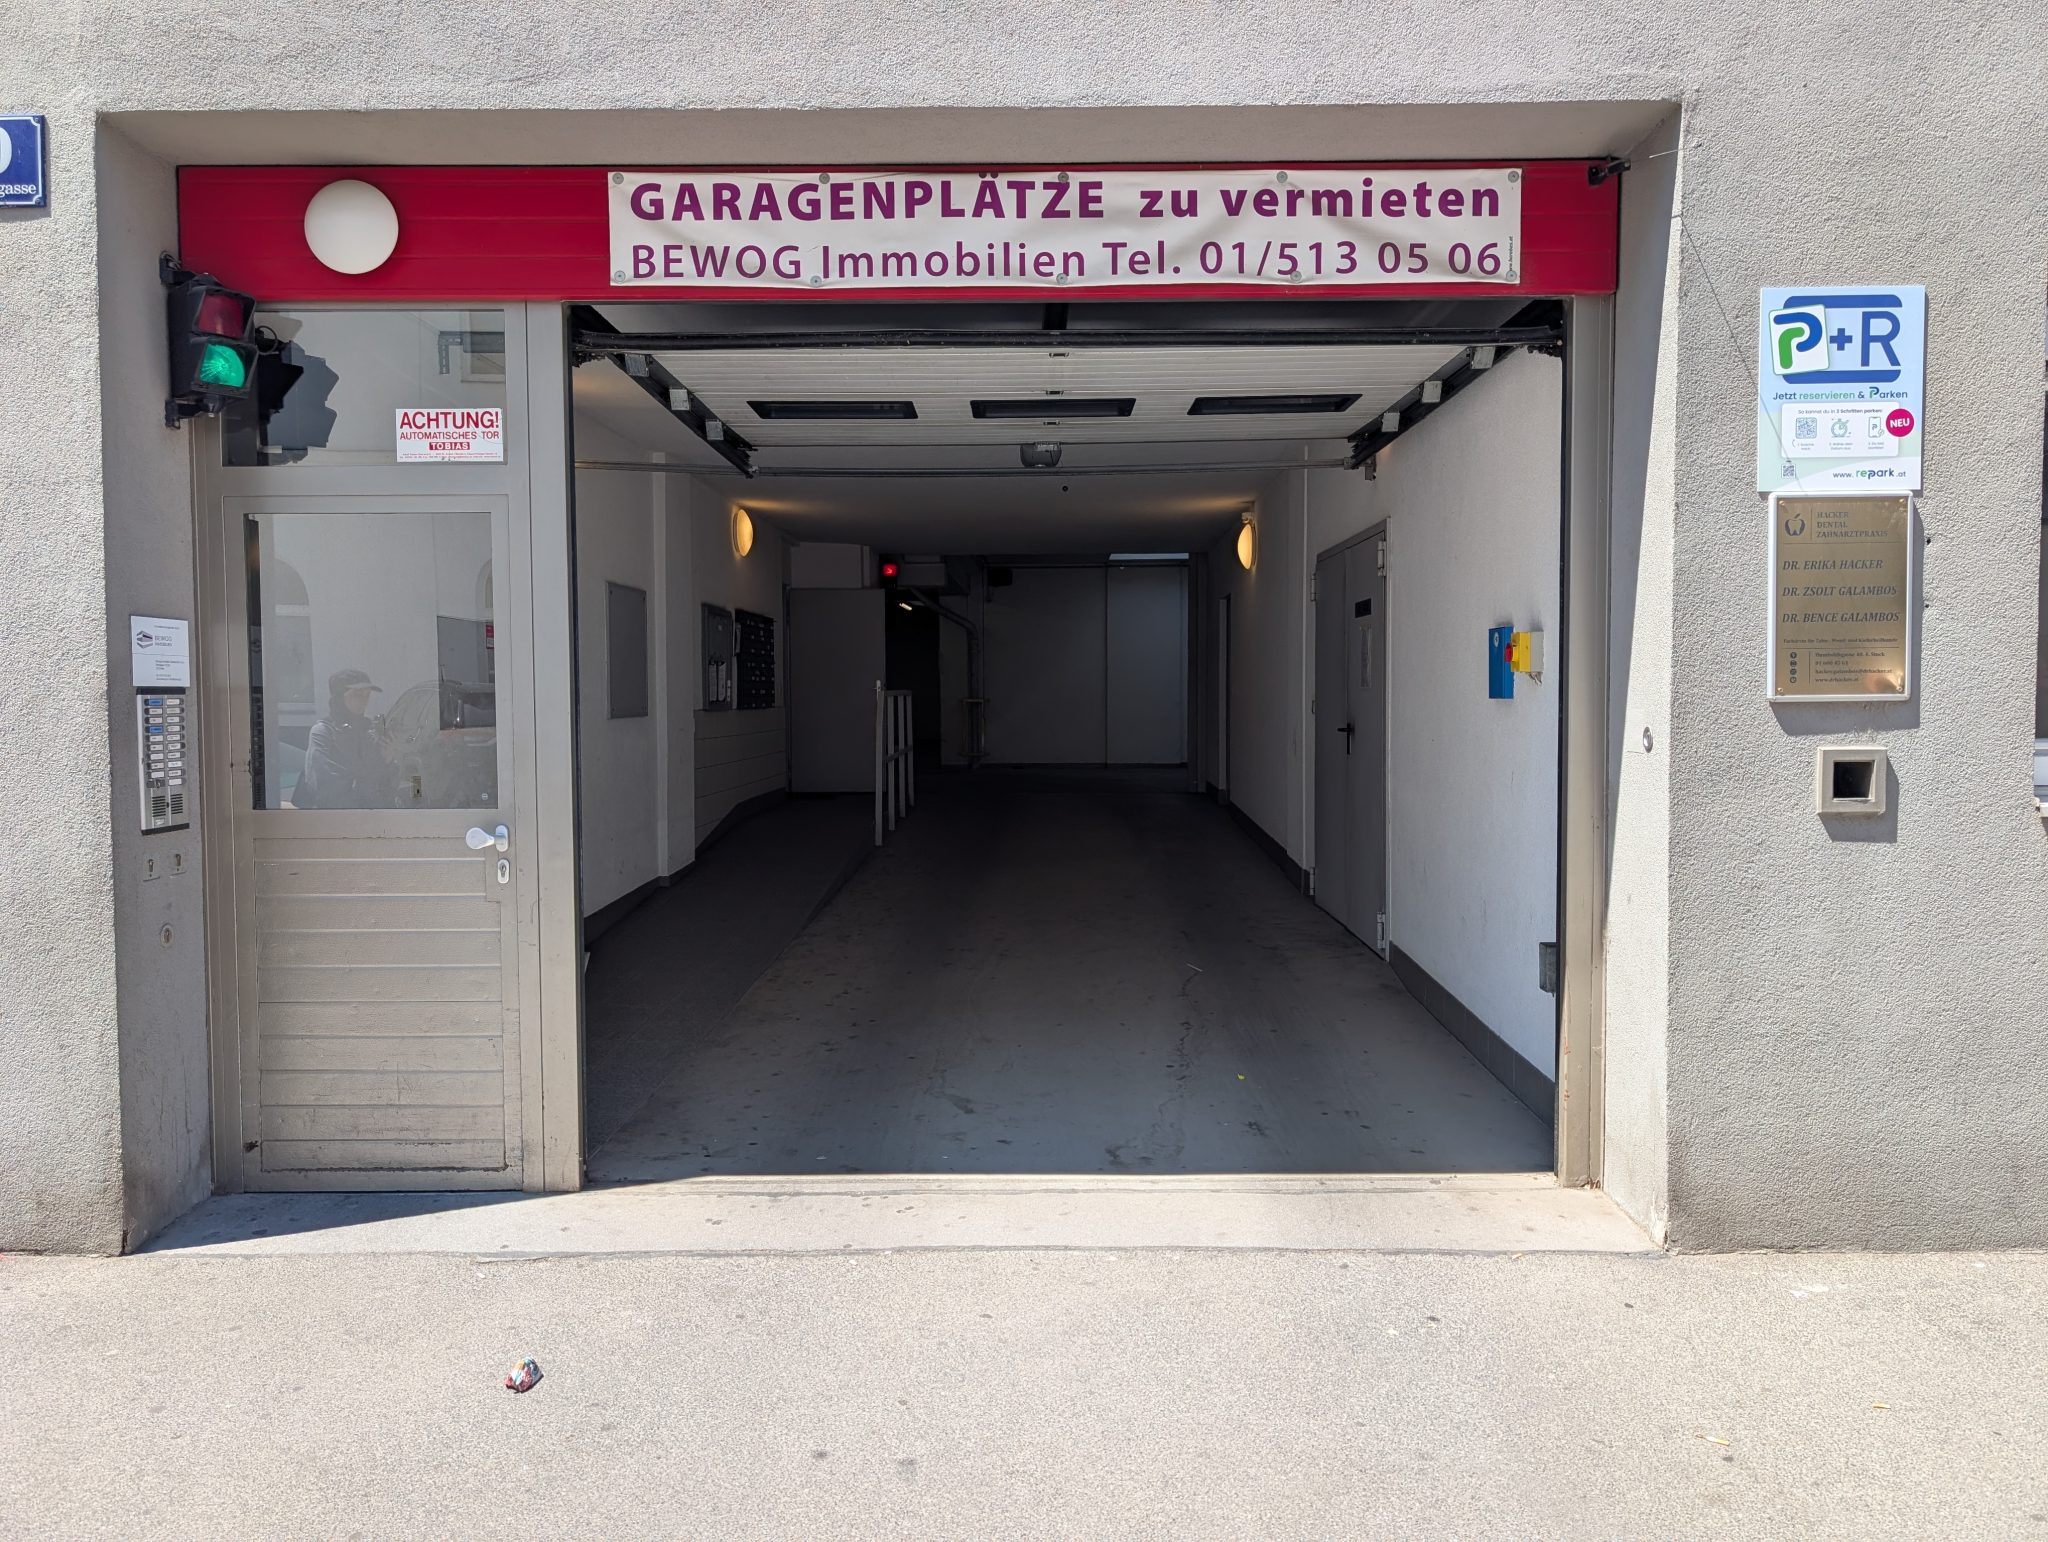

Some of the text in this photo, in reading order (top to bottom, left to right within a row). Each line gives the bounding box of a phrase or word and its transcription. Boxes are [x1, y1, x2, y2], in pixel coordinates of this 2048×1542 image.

[630, 172, 1500, 221] GARAGENPLÄTZE zu vermieten
[632, 244, 802, 280] BEWOG
[822, 240, 1085, 279] Immobilien
[1102, 240, 1182, 276] Tel.
[1199, 241, 1358, 277] 01/513
[1377, 242, 1429, 275] 05
[1447, 242, 1501, 276] 06
[1773, 386, 1908, 401] Jetzt reservieren & Parken
[399, 411, 499, 430] ACHTUNG!
[1889, 418, 1910, 428] NEU
[399, 431, 500, 440] AUTOMATISCHES TOR
[431, 442, 469, 450] TOBIAS
[1816, 511, 1849, 519] HACKER
[1816, 521, 1848, 529] DENTAL
[1816, 530, 1888, 538] ZAHNARZTPRAXIS
[1782, 559, 1884, 570] DR. ERIKA HACKER
[1782, 585, 1897, 597] DR. ZSOLT GALAMBOS
[1782, 612, 1899, 623] DR. BENCE GALAMBOS
